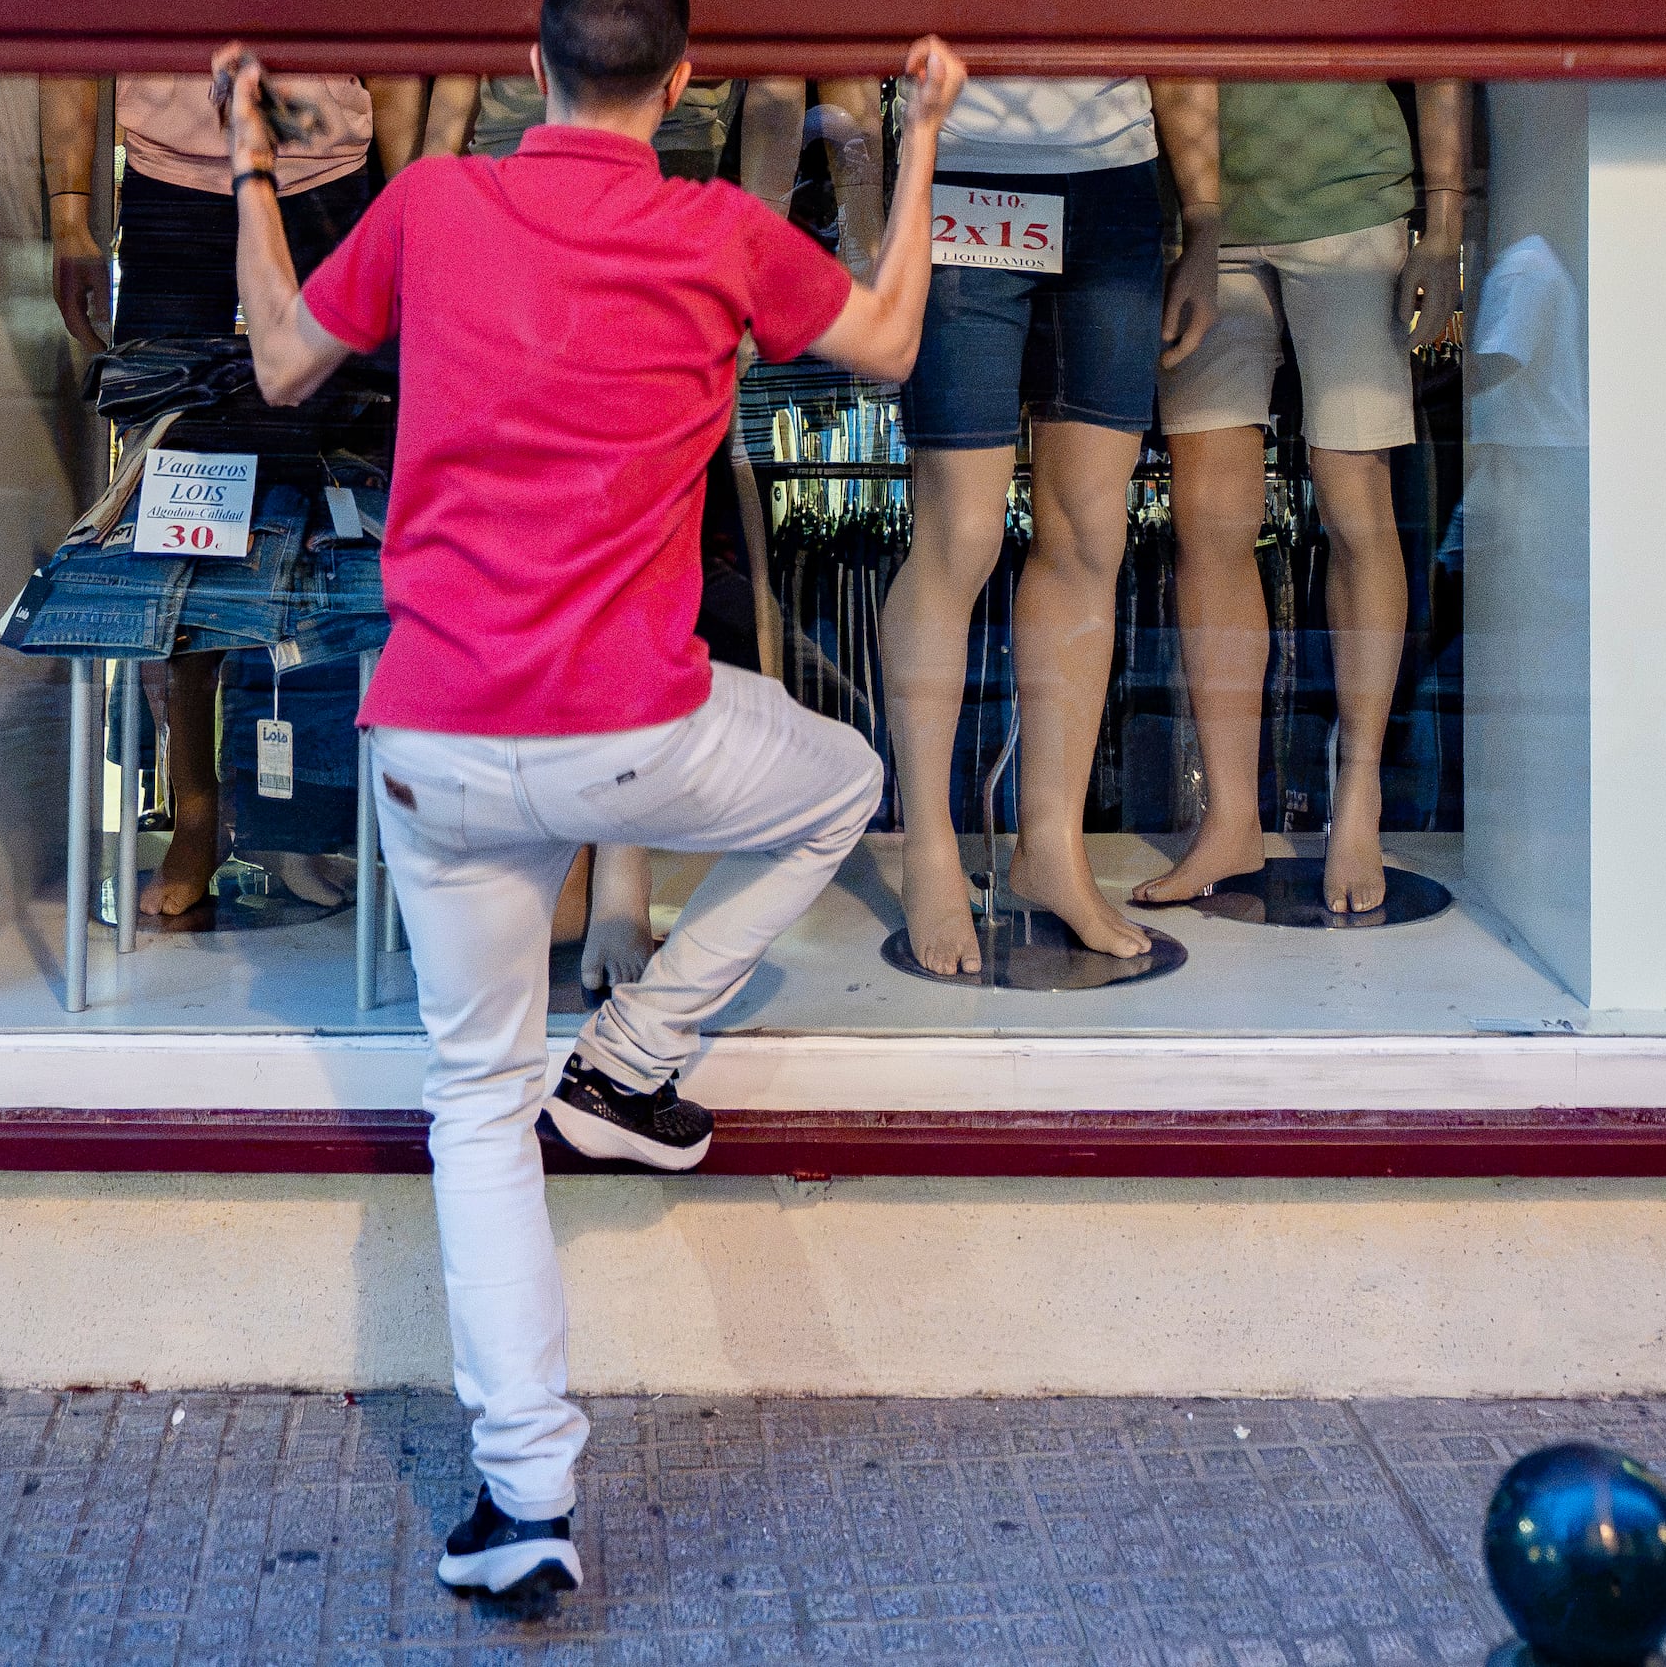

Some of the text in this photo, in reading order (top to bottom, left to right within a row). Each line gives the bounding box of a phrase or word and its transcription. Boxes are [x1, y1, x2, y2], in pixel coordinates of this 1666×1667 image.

[942, 252, 1045, 268] LIQUIDAMOS
[156, 456, 248, 478] Vaqueros
[170, 483, 227, 502] LOIS
